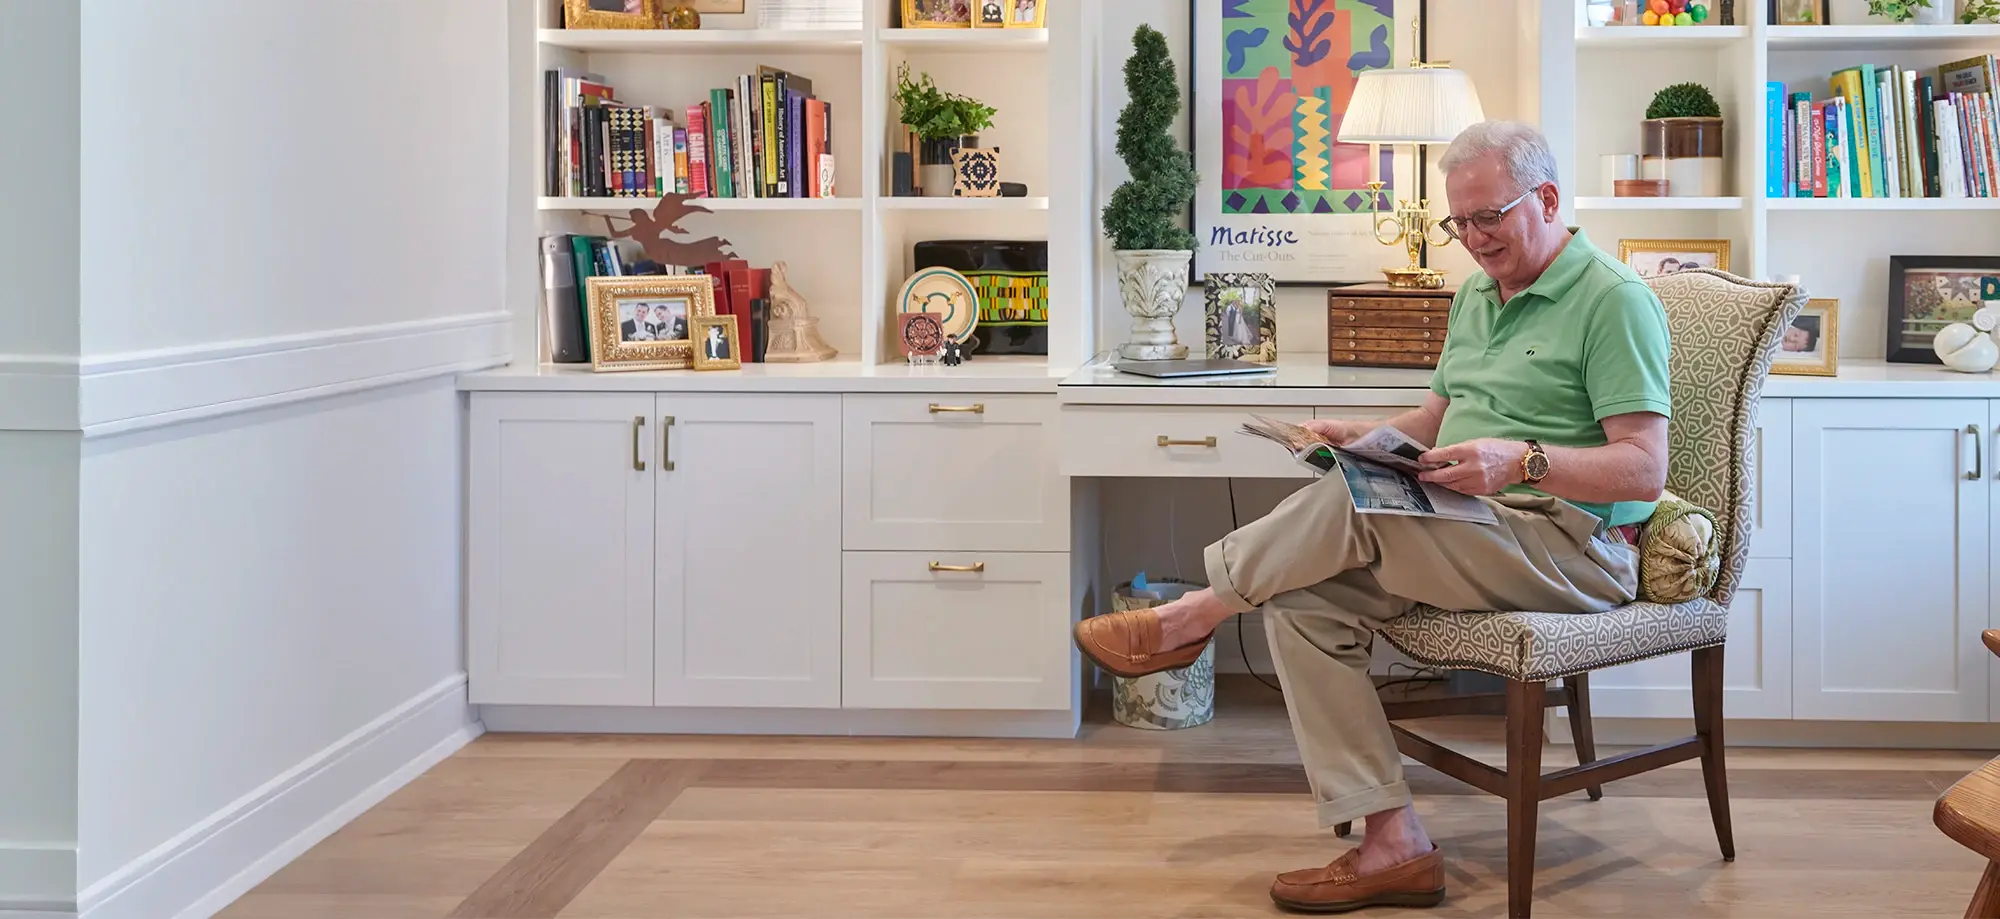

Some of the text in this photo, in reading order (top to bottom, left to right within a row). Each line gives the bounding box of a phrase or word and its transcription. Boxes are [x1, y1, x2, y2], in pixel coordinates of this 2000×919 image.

[777, 108, 785, 131] History
[662, 132, 671, 147] Art
[689, 132, 705, 163] GAME
[1210, 225, 1299, 247] Matisse
[1219, 250, 1240, 262] The
[1242, 250, 1295, 262] Cut-Outs
